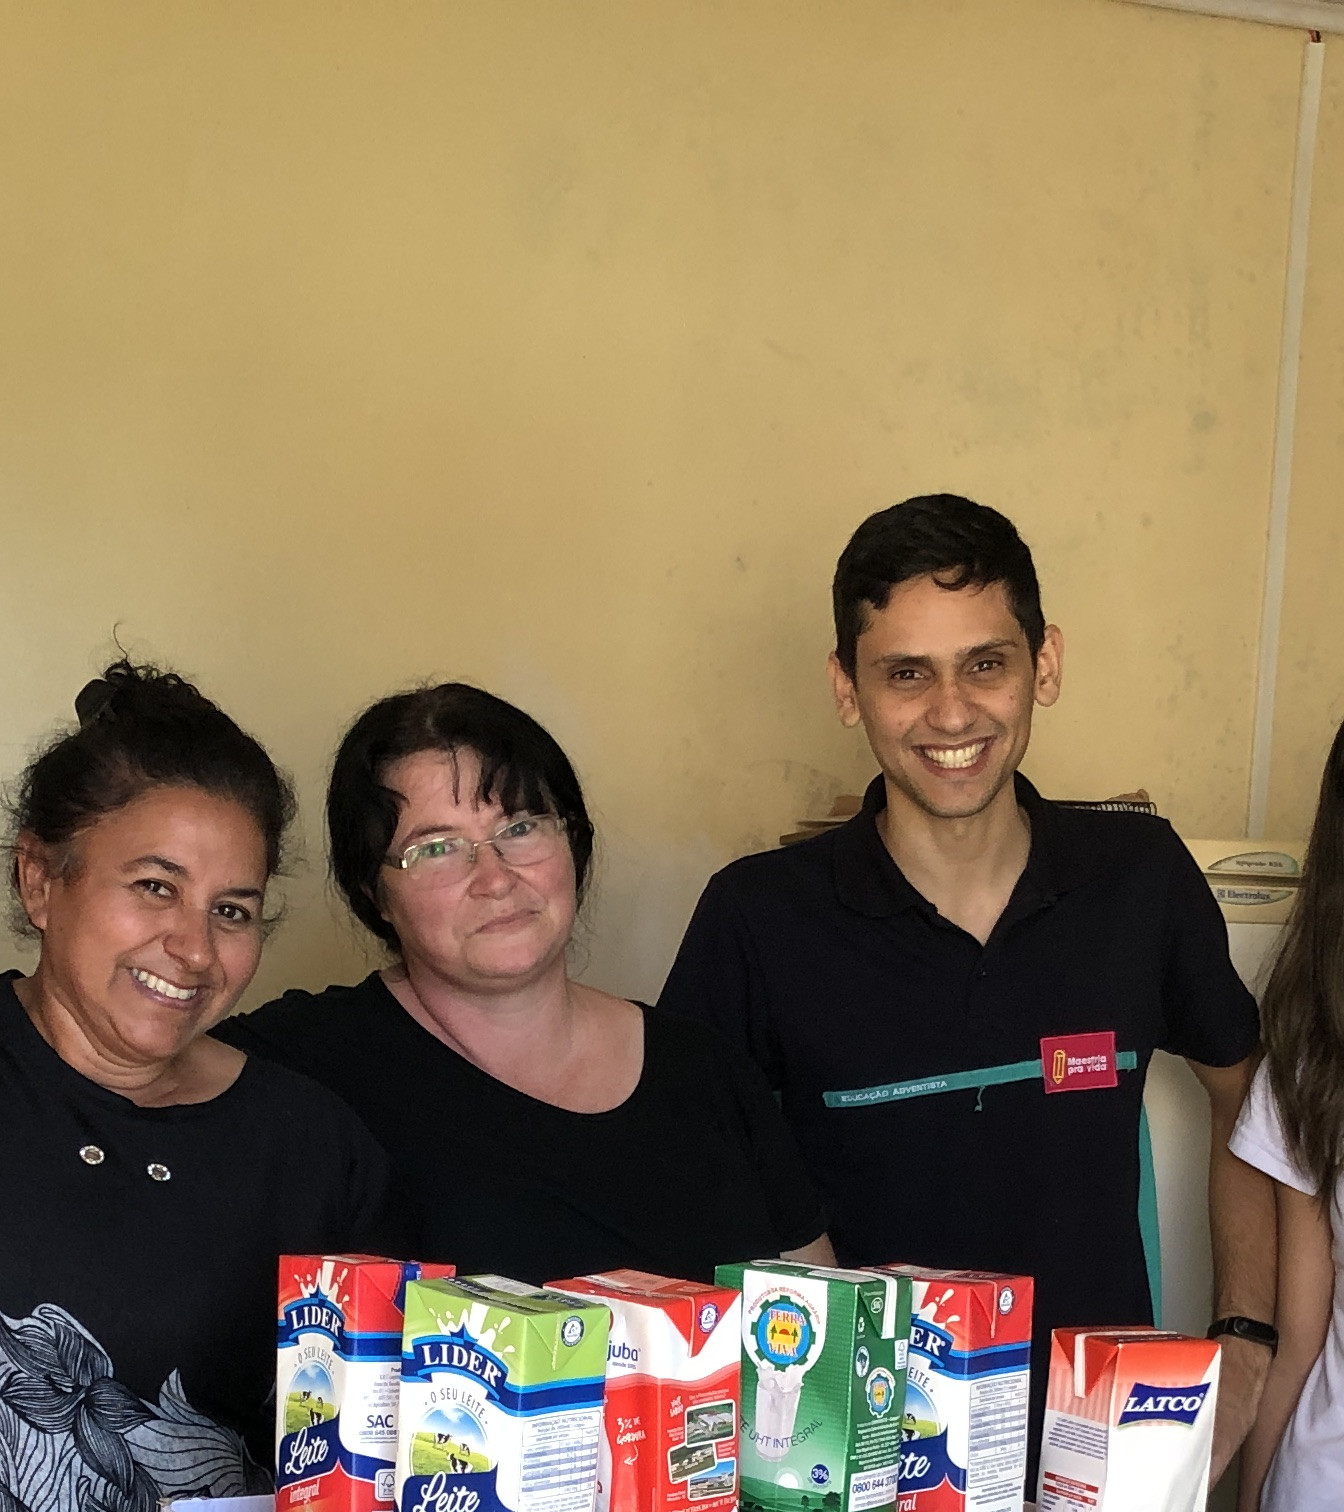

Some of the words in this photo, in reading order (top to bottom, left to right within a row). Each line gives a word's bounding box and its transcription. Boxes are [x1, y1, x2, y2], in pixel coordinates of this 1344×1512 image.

[1067, 1054, 1107, 1066] Maestria
[1067, 1066, 1084, 1076] pra
[1087, 1063, 1107, 1072] vida
[841, 1088, 889, 1102] EDUCAÇÃO
[892, 1080, 948, 1096] ADVENTISTA
[291, 1305, 342, 1338] LIDER
[770, 1309, 805, 1326] TERRA
[304, 1348, 316, 1361] SEU
[317, 1349, 334, 1370] LEITE
[769, 1343, 798, 1358] VIVA
[422, 1343, 501, 1388] LIDER
[908, 1367, 930, 1388] EITE
[430, 1391, 437, 1402] O
[440, 1388, 458, 1401] SEU
[461, 1390, 486, 1419] LEITE
[1124, 1394, 1203, 1413] LATCO
[366, 1414, 394, 1429] SAC
[748, 1429, 771, 1448] UHT
[772, 1418, 823, 1449] INTEGRAL
[284, 1426, 329, 1475] Leite
[812, 1468, 829, 1481] 3%
[898, 1451, 931, 1481] ite
[289, 1477, 321, 1504] integral
[852, 1481, 870, 1494] 0800
